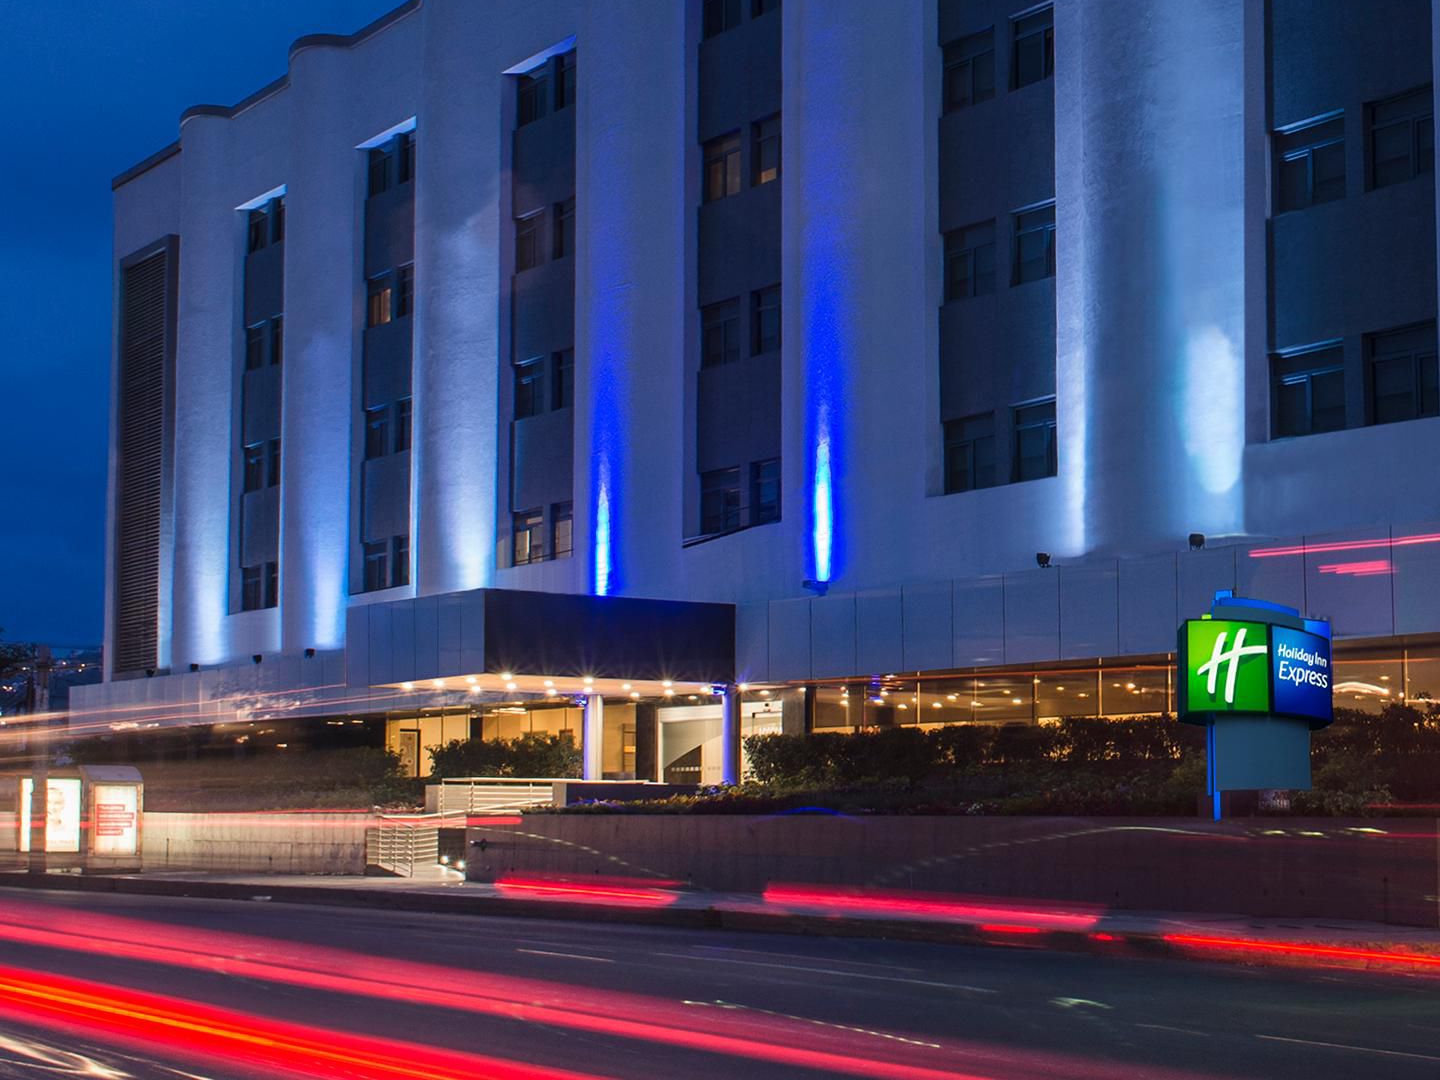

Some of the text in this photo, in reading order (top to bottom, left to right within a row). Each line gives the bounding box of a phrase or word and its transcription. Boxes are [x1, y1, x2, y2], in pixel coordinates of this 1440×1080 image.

[1277, 643, 1328, 668] Holiday Inn
[1278, 660, 1328, 689] Express
